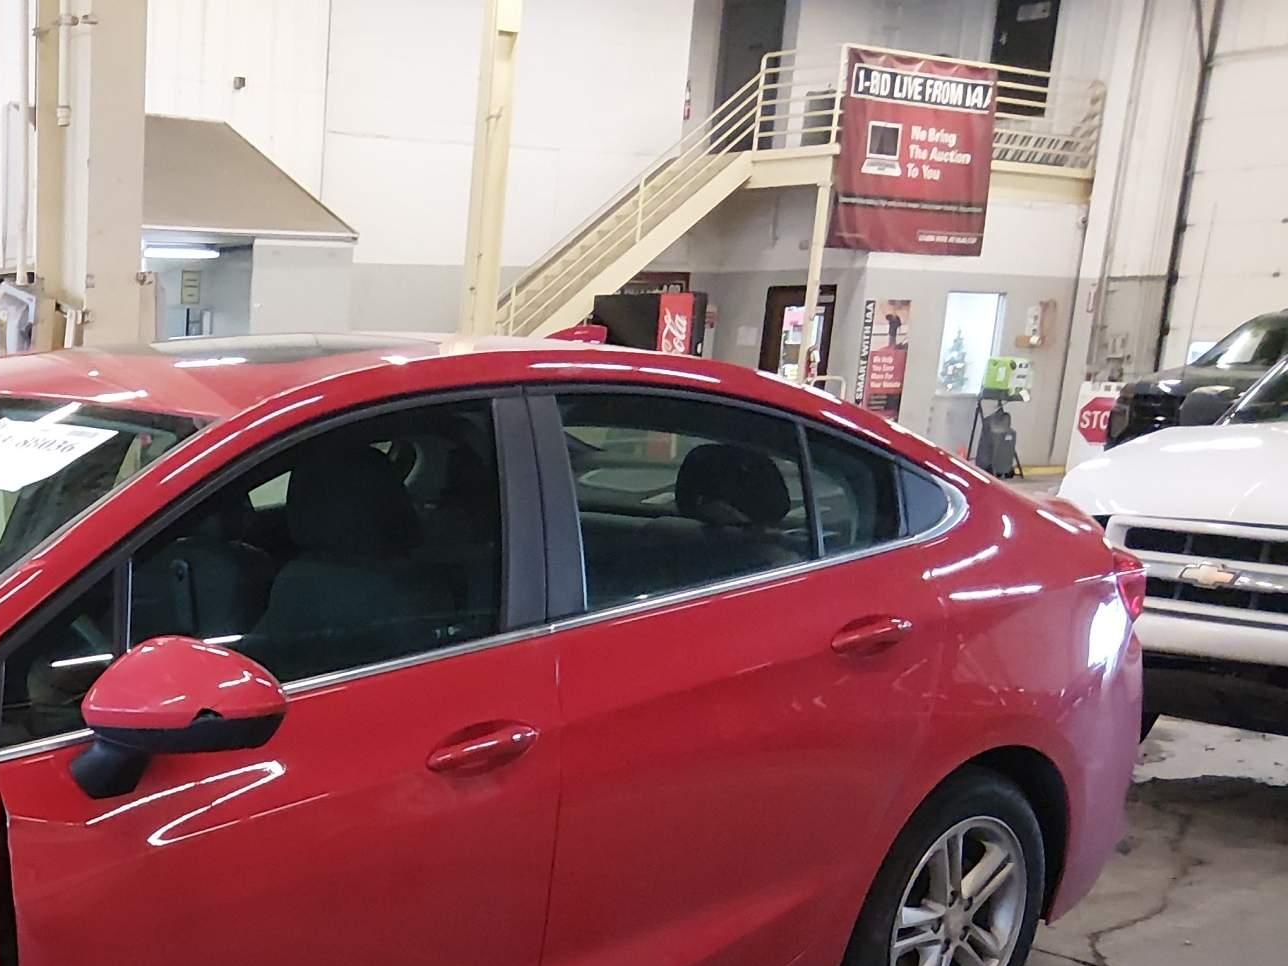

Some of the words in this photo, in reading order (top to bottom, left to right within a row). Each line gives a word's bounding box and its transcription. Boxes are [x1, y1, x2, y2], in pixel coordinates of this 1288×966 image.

[894, 75, 924, 100] LIVE
[925, 79, 962, 106] FROM
[928, 127, 957, 147] Bring
[909, 144, 928, 160] The
[929, 146, 972, 165] Auction
[906, 163, 920, 178] To
[922, 164, 941, 180] You
[865, 302, 875, 323] IAA
[860, 326, 872, 357] WITH
[855, 359, 868, 400] SMART
